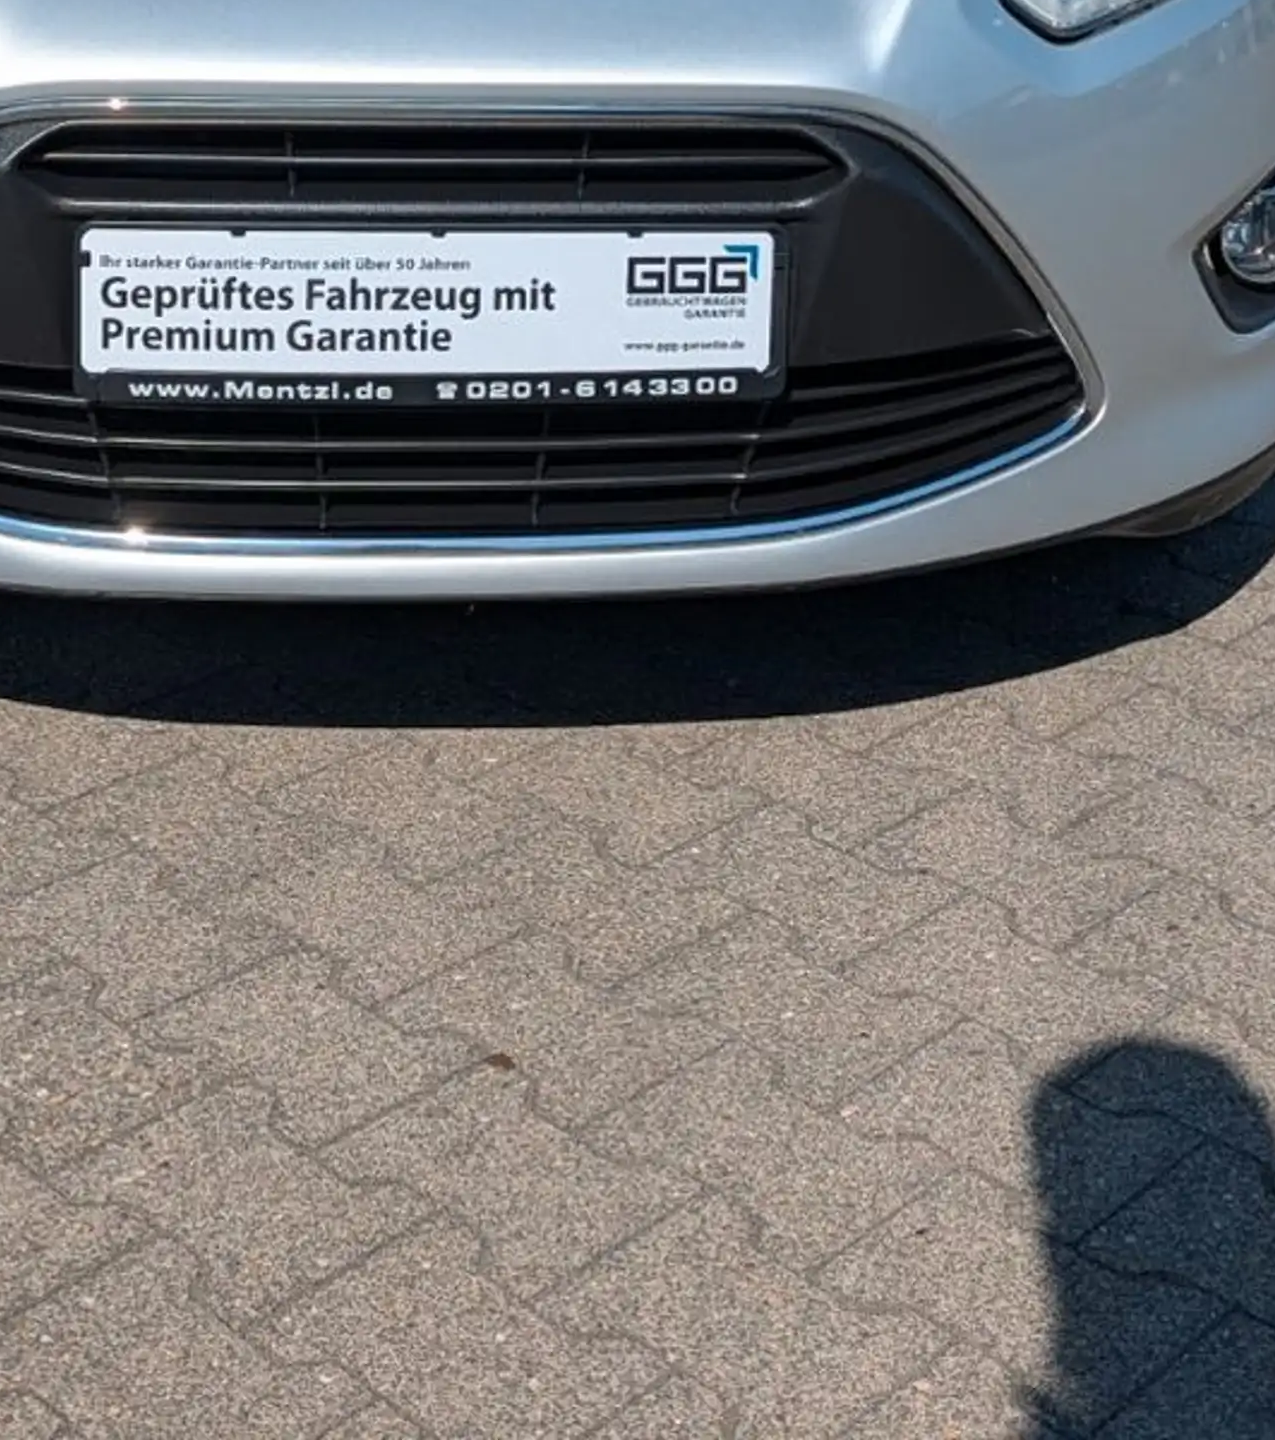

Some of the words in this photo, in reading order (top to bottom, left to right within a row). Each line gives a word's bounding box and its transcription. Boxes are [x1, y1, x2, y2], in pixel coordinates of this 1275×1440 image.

[99, 254, 122, 268] Ihr
[126, 255, 180, 270] starker
[186, 256, 319, 271] Garantie-Partner
[323, 256, 351, 271] seit
[355, 256, 391, 271] über
[395, 257, 415, 271] 50
[418, 256, 471, 271] Jahren
[626, 257, 748, 294] GGG
[100, 276, 295, 317] Geprüftes
[305, 277, 481, 319] Fahrzeug
[494, 278, 556, 311] mit
[101, 318, 276, 351] Premium
[286, 319, 452, 352] Garantie
[128, 379, 394, 402] www.Mentzl.de
[466, 375, 739, 399] 0201-6143300
